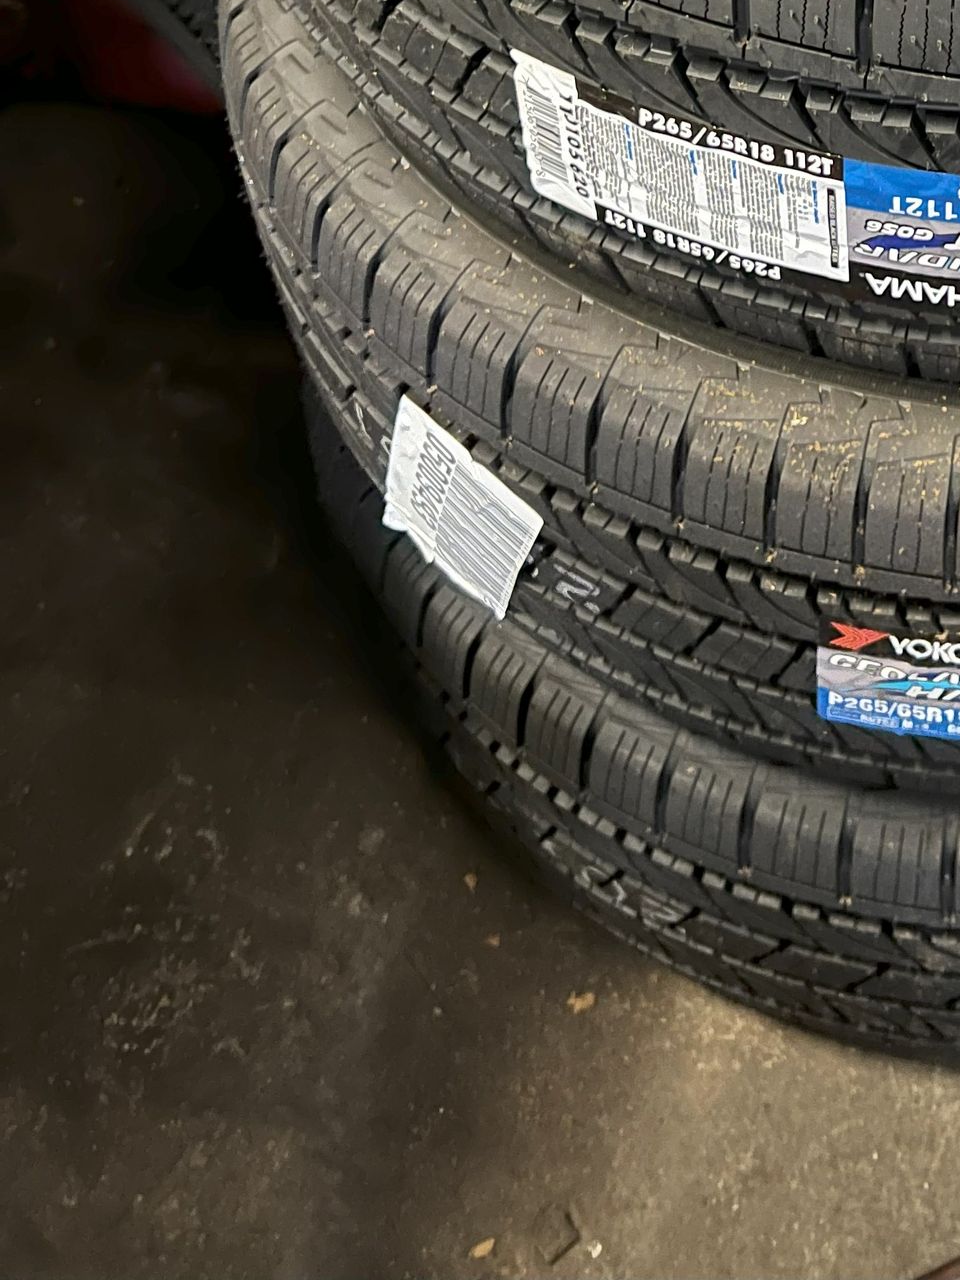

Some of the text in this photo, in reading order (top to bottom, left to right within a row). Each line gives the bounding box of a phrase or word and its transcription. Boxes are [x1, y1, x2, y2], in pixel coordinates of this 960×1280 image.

[638, 108, 834, 176] P265/65R18 112T
[865, 219, 935, 241] G056
[889, 196, 958, 220] 112T
[604, 209, 782, 280] P265/65R18 112T
